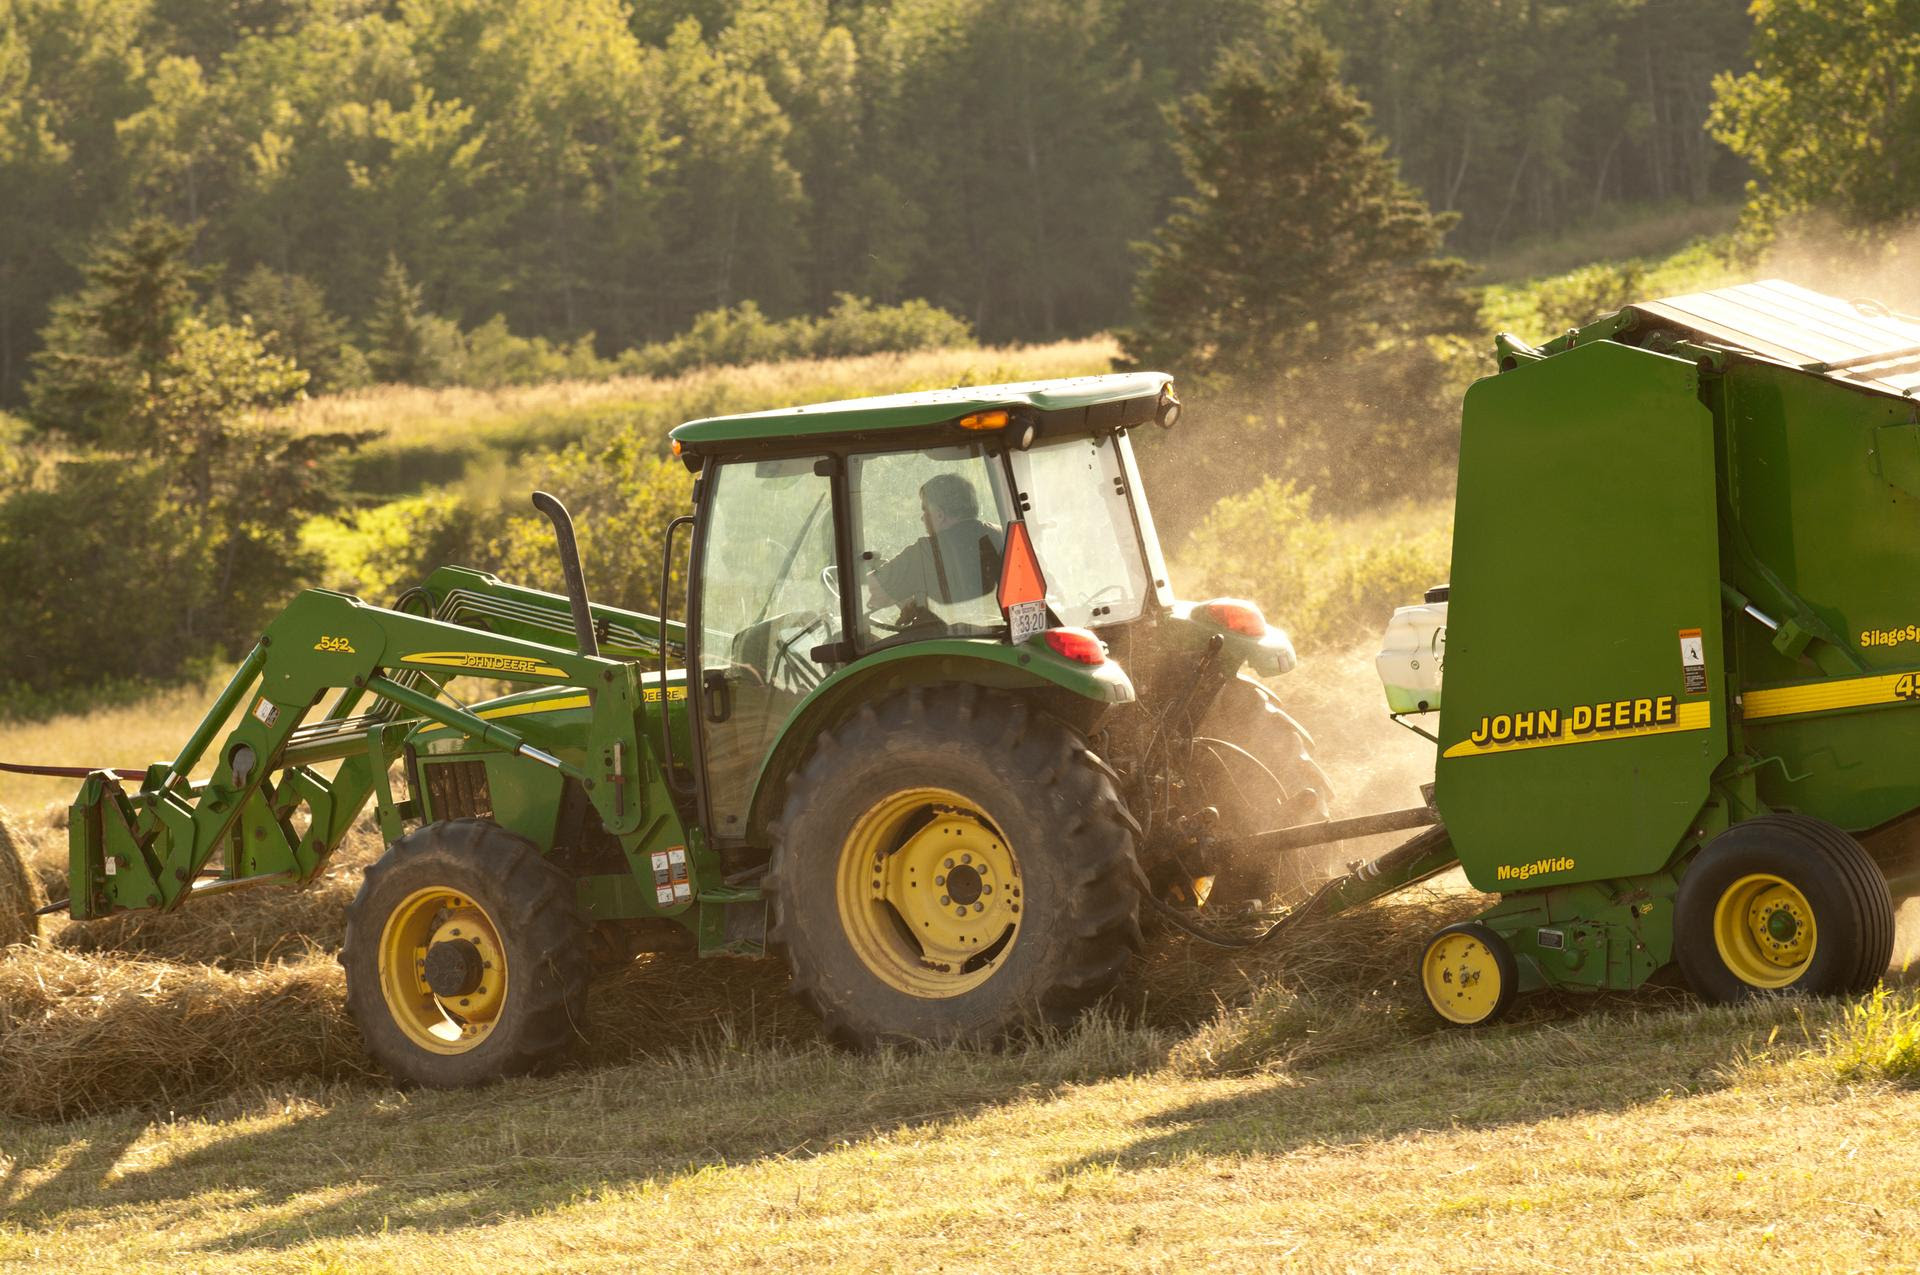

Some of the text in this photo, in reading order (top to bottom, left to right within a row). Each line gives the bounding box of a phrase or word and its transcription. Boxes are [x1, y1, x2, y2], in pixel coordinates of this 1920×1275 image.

[320, 635, 349, 651] 542
[1470, 695, 1675, 745] JOHN DEERE
[1497, 856, 1575, 880] MegaWide
